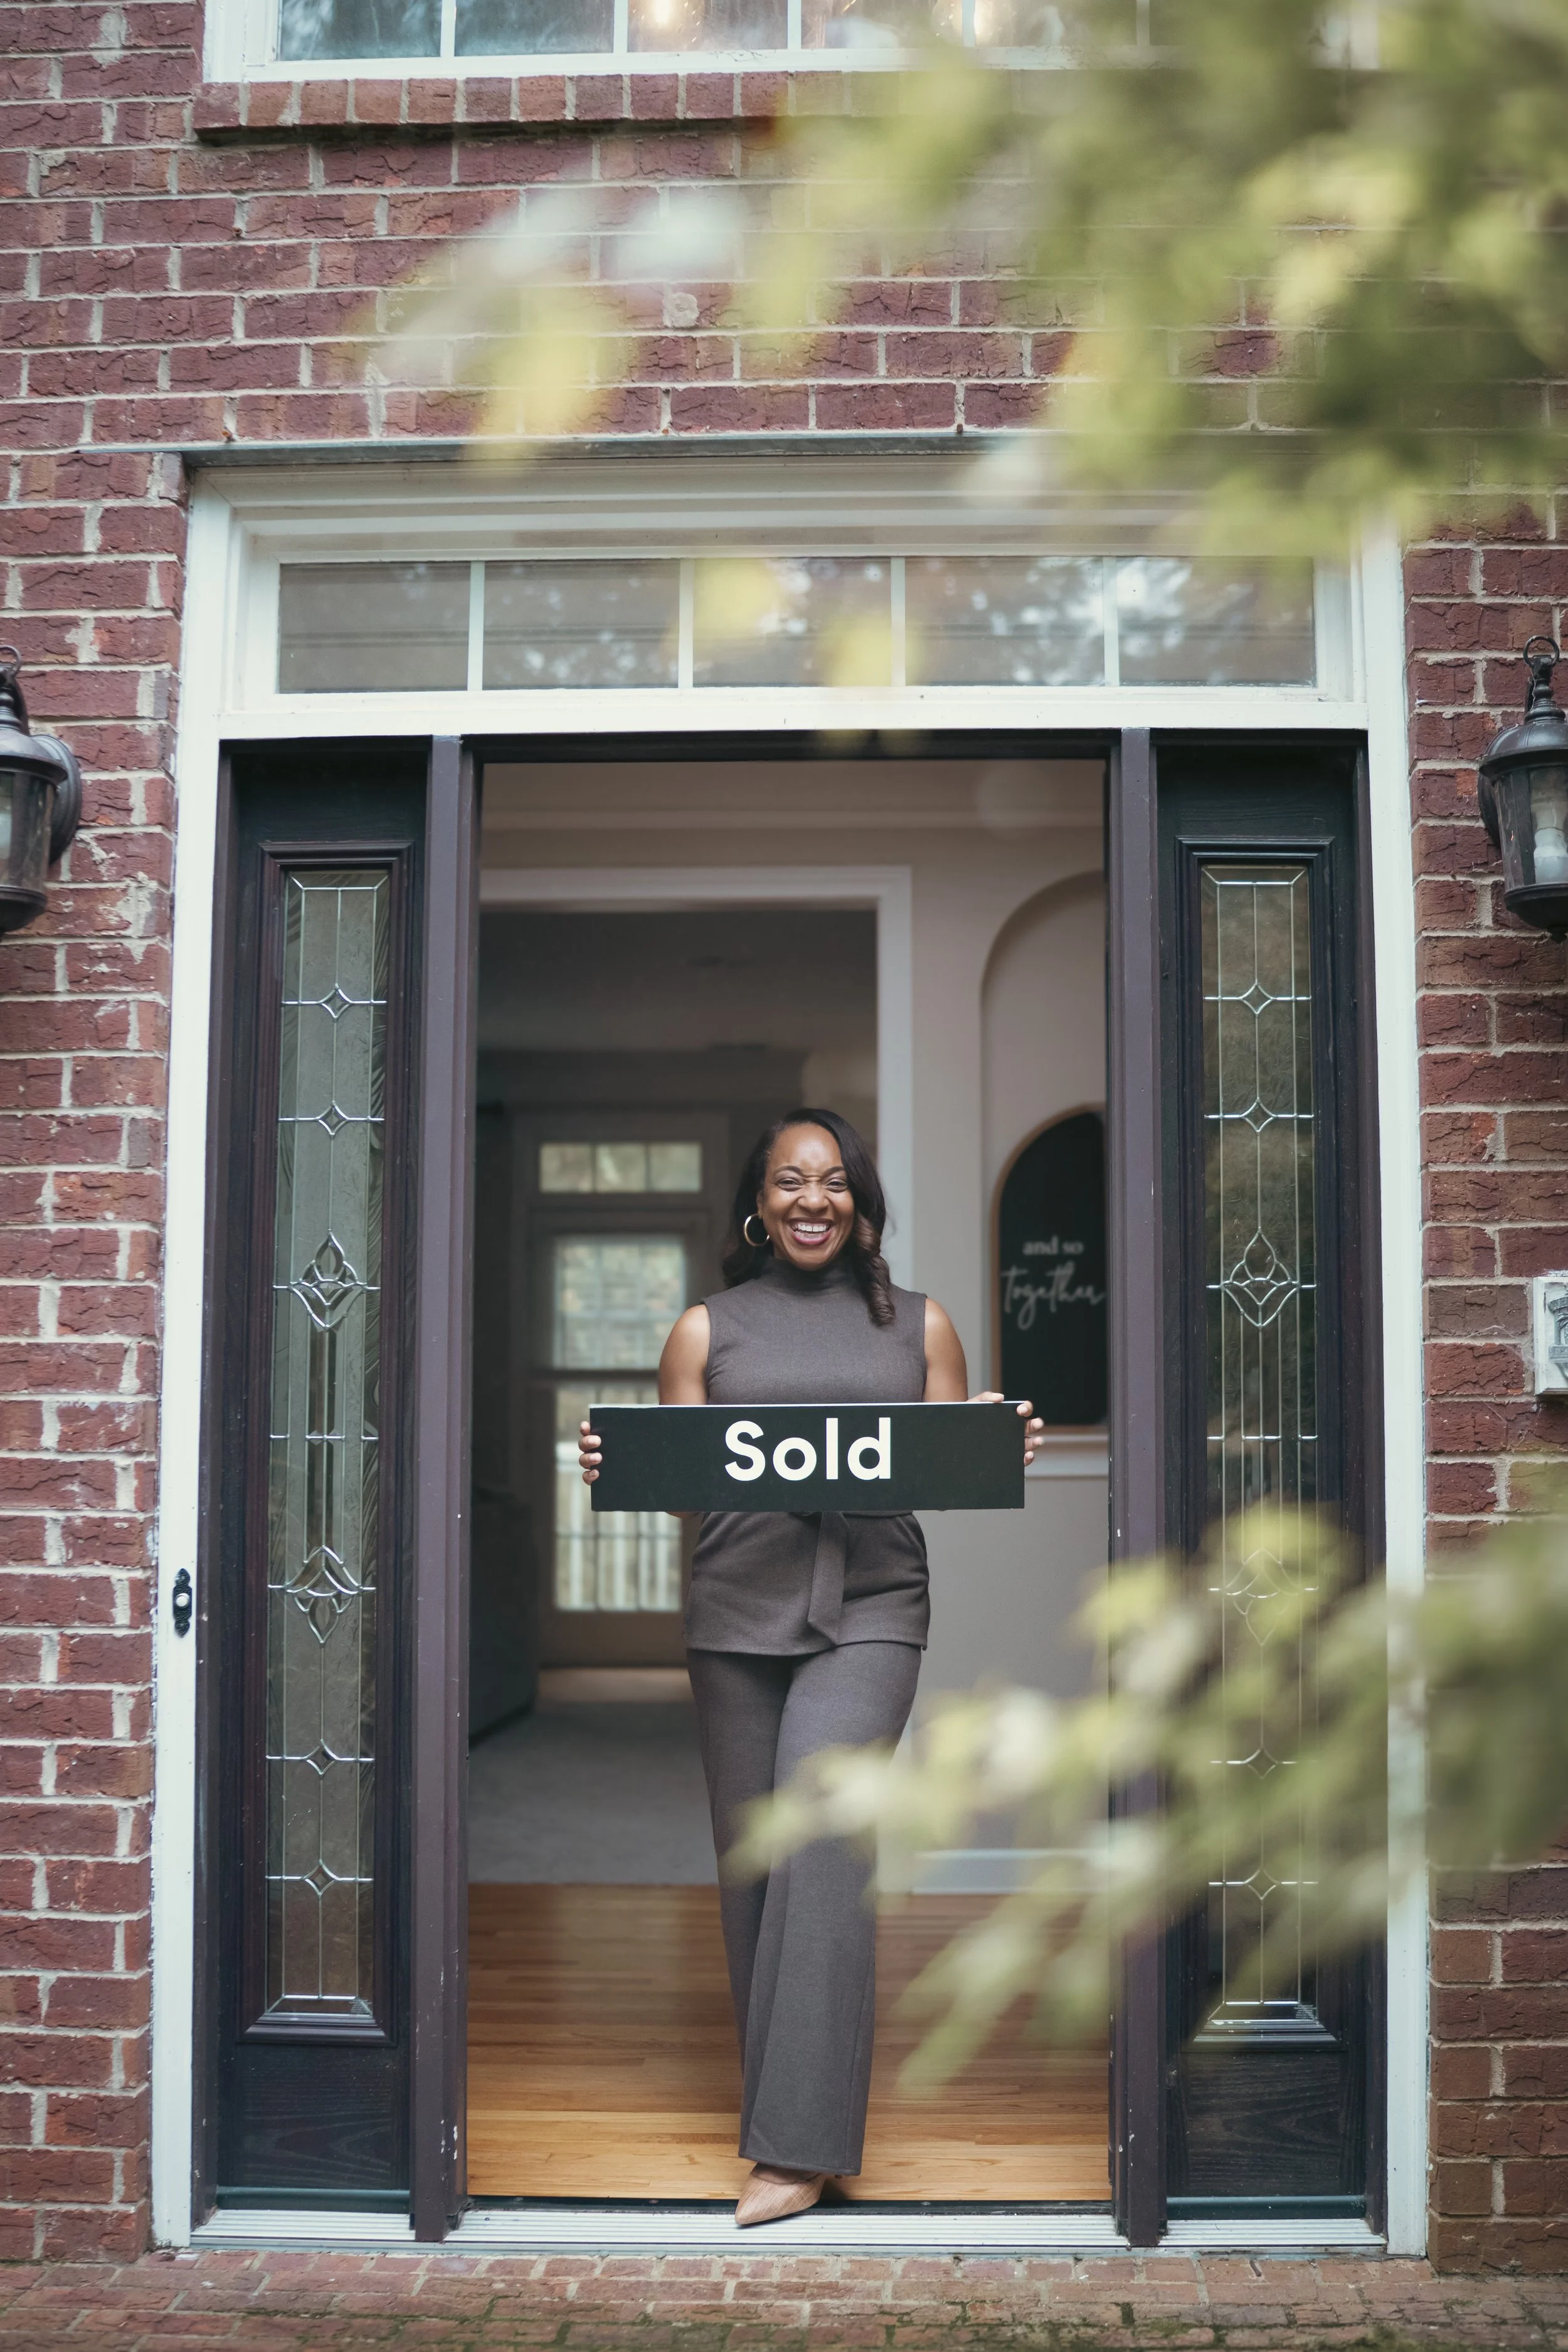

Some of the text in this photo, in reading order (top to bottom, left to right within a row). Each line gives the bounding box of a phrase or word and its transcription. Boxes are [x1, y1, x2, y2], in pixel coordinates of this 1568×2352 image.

[1023, 1235, 1084, 1255] and so
[724, 1417, 891, 1481] Sold
